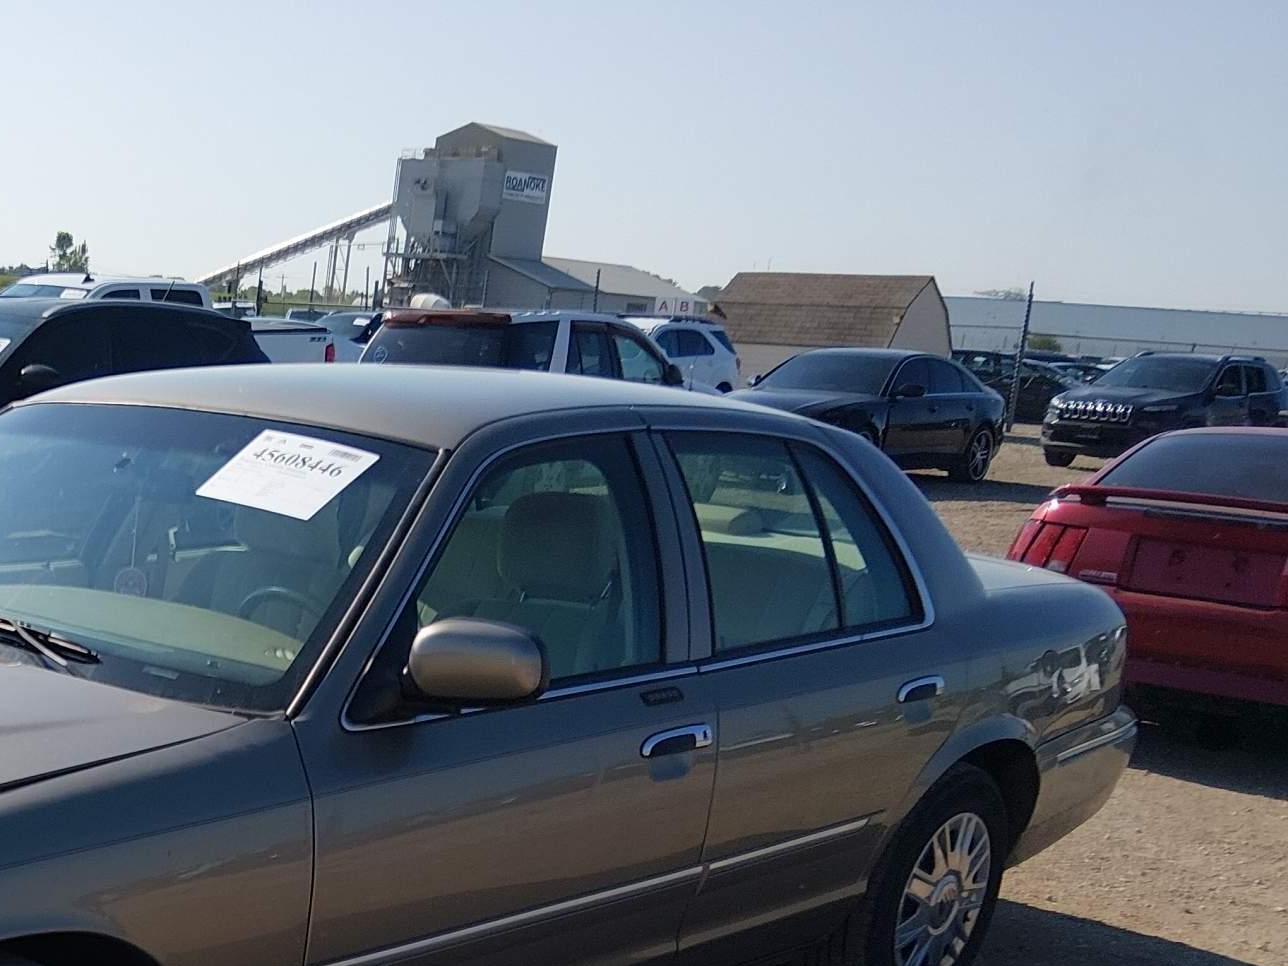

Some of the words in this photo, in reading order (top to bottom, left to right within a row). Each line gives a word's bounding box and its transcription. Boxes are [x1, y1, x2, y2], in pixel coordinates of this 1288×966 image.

[657, 300, 669, 312] A
[679, 301, 690, 313] B
[253, 447, 346, 478] 45608446
